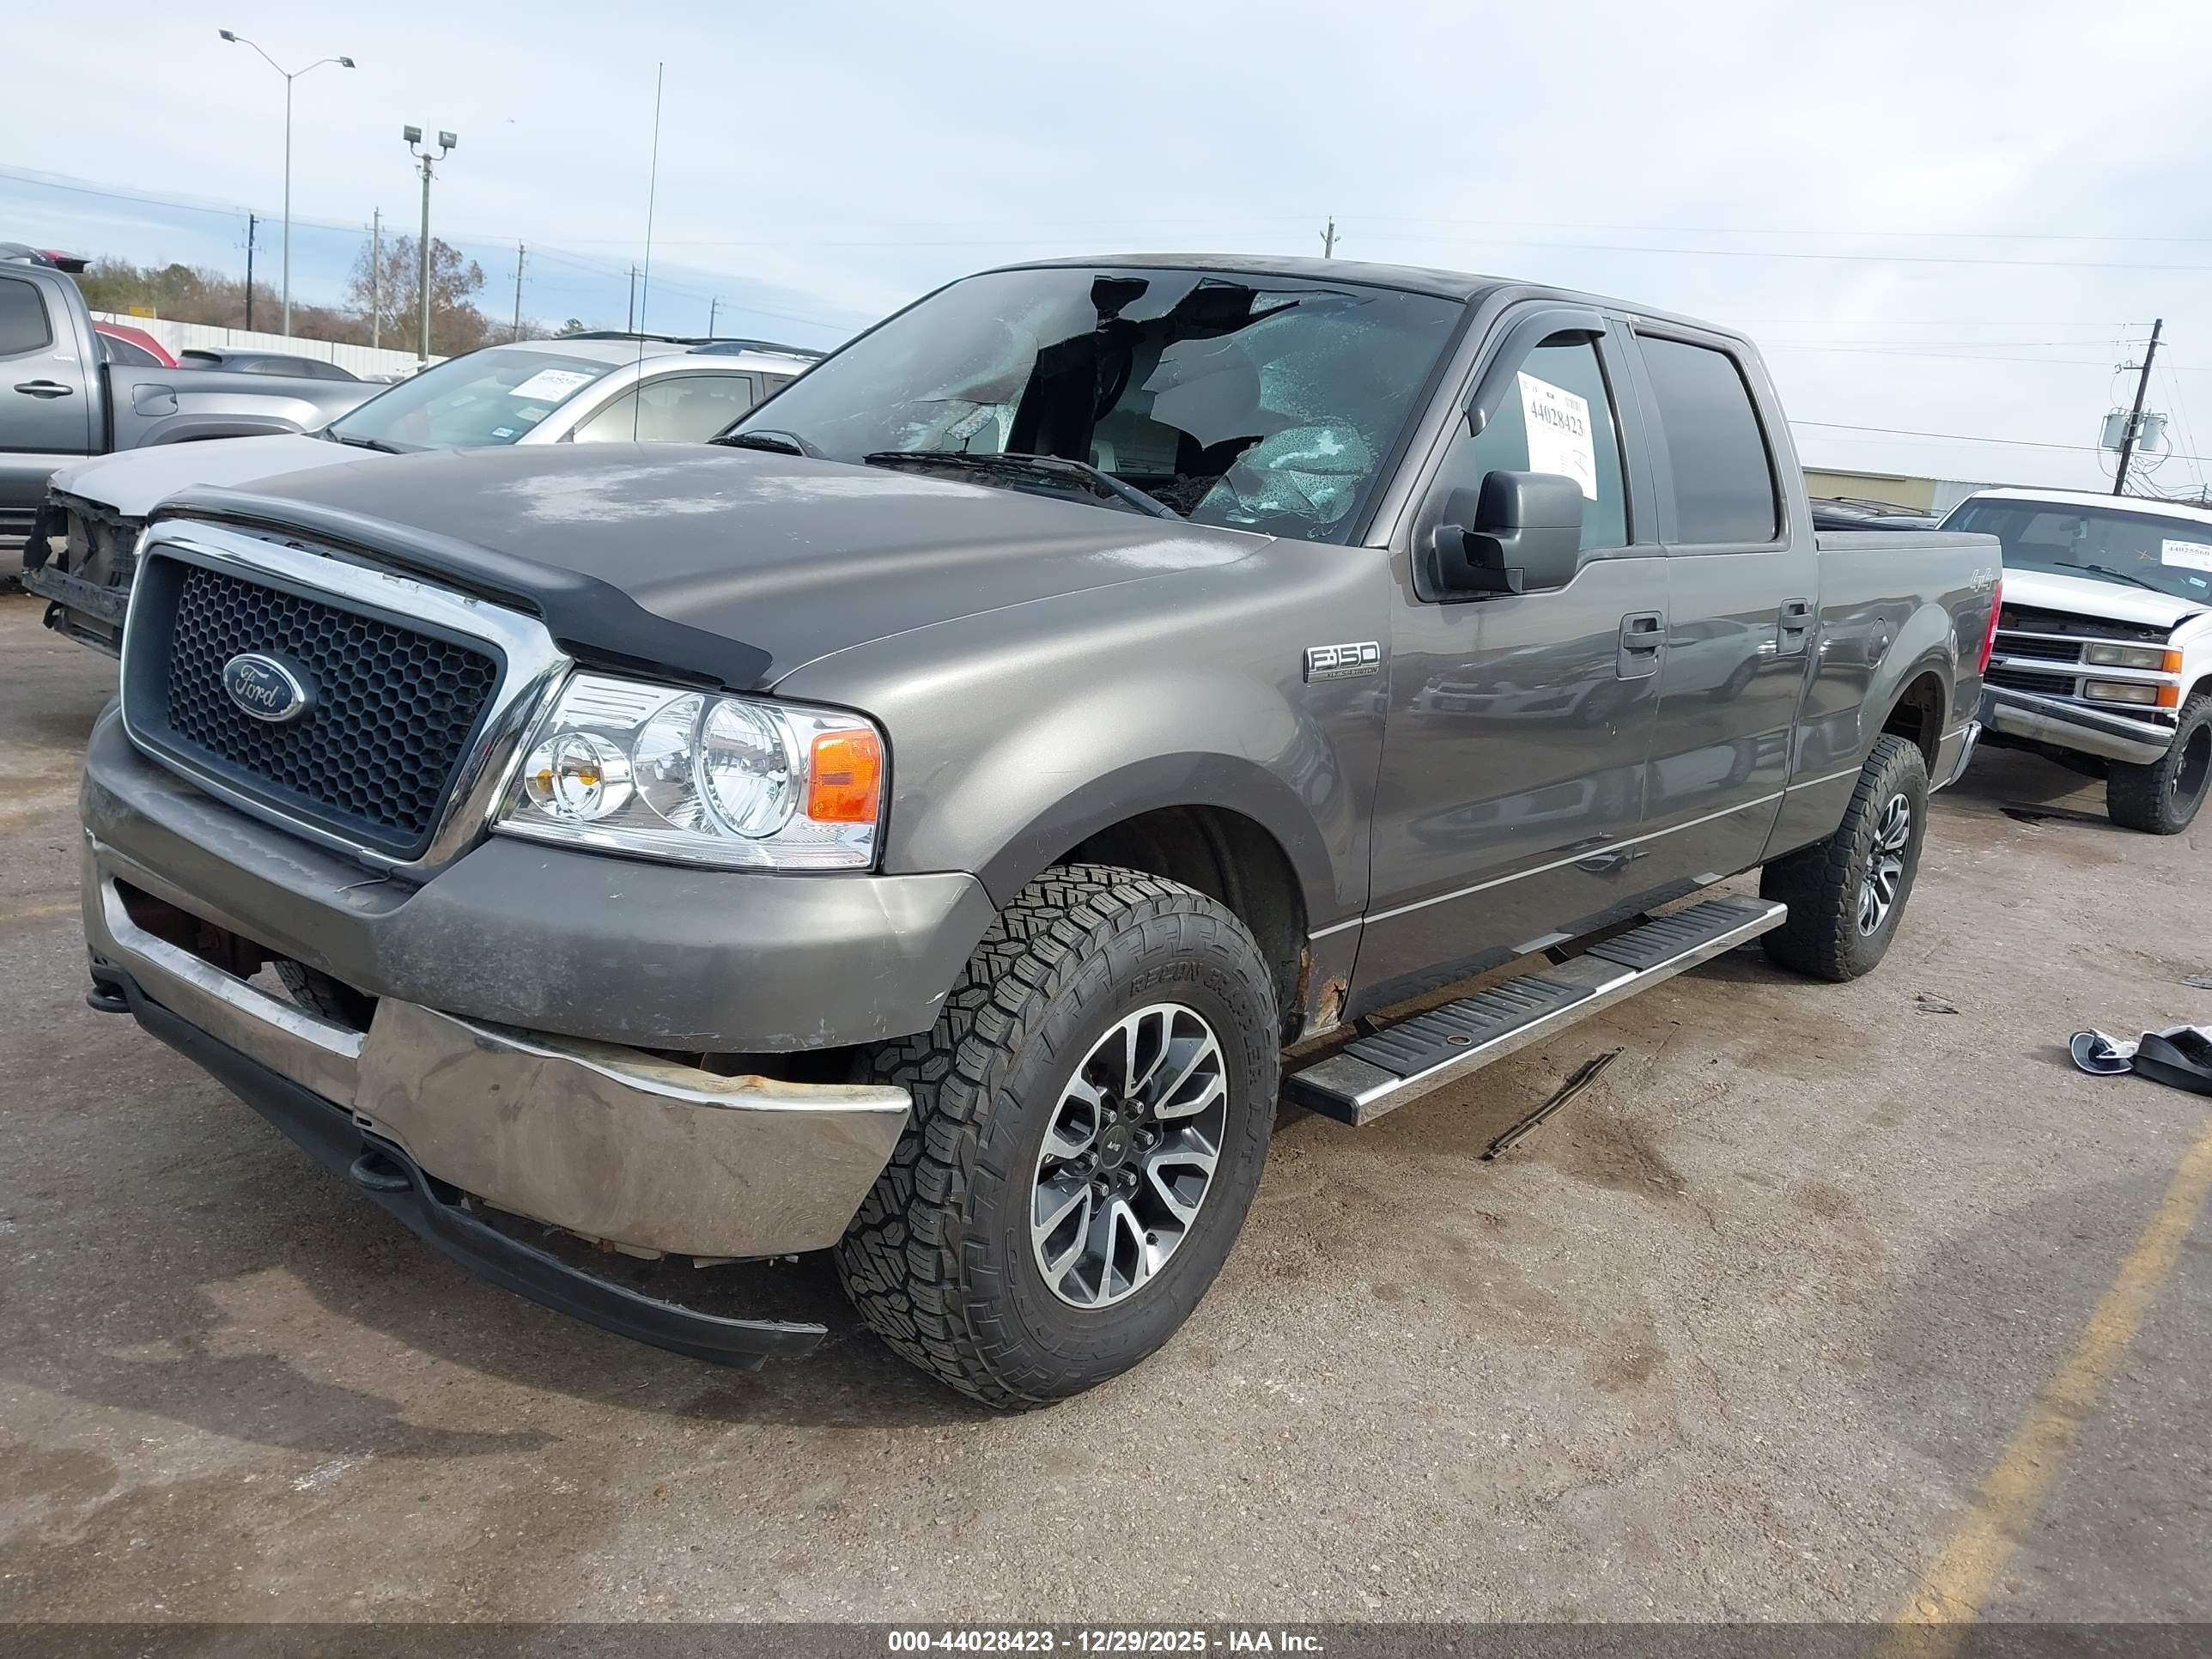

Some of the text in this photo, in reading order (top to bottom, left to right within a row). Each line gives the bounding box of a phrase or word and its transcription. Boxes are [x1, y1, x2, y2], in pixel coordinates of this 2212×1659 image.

[1530, 400, 1584, 436] 44028423
[234, 665, 279, 707] Ford
[1130, 961, 1202, 998] RECON
